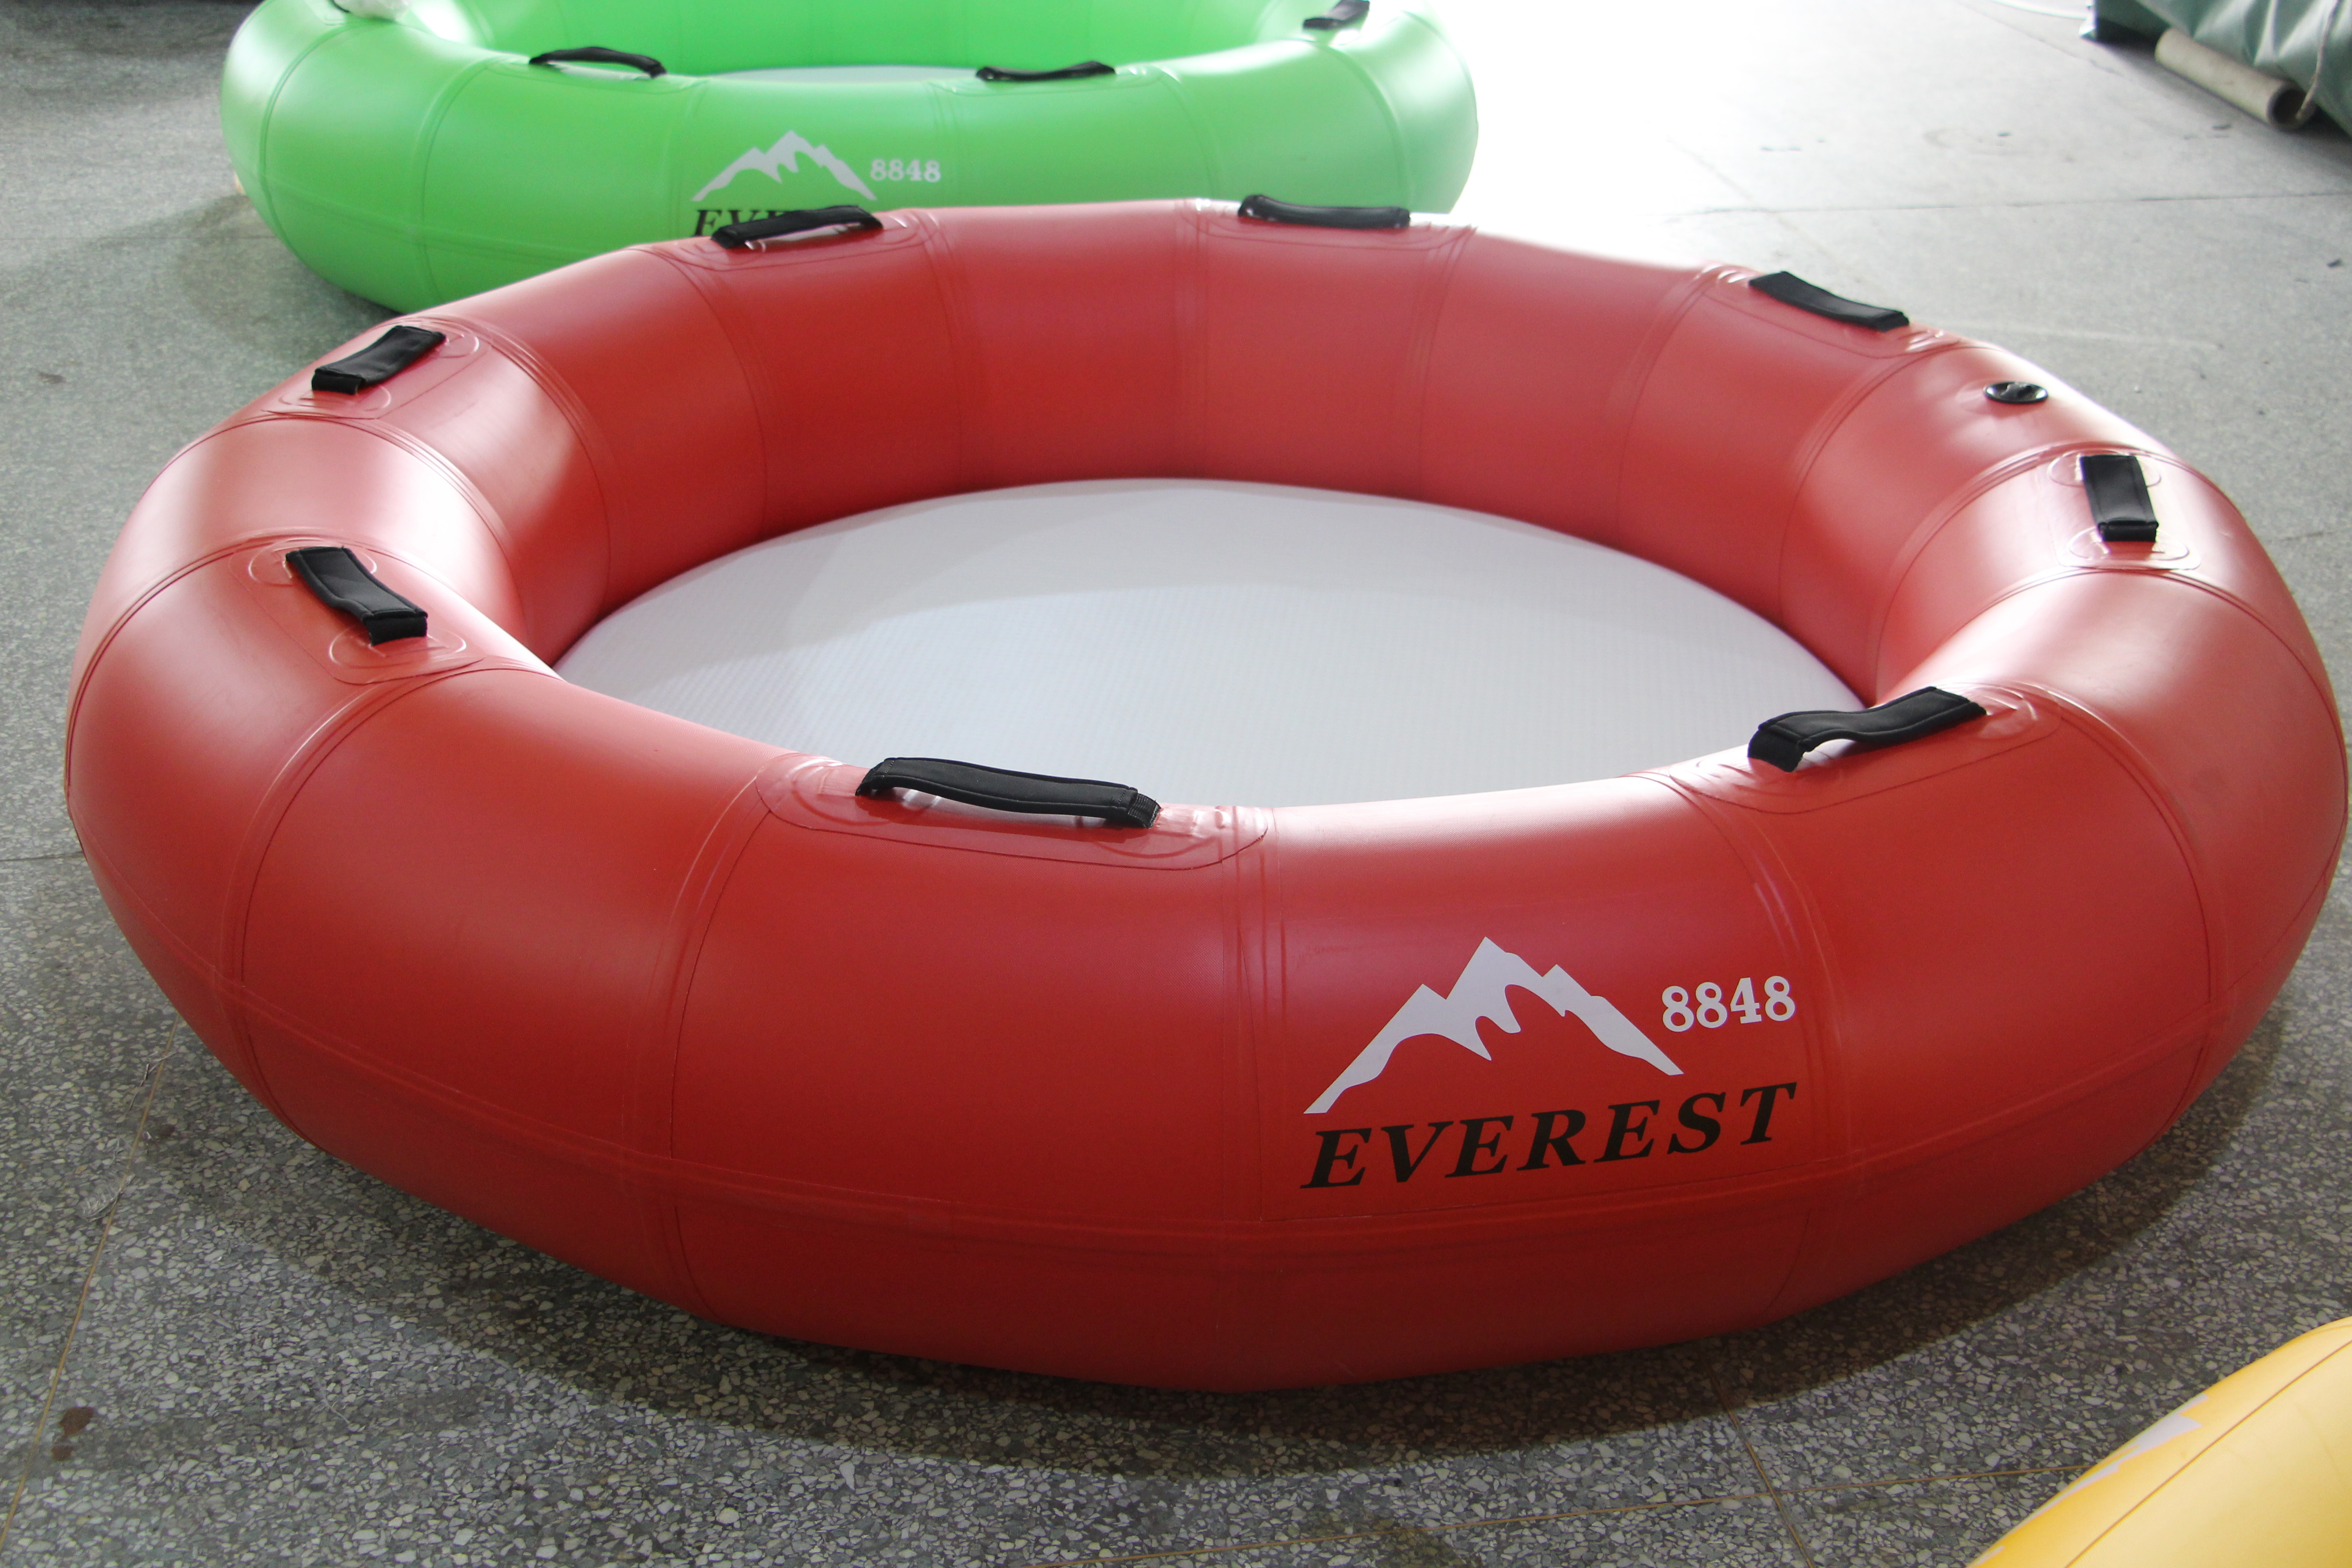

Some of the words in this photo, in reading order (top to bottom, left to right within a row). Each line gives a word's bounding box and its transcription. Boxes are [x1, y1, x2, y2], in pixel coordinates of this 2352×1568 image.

[870, 158, 941, 182] 8848
[1661, 975, 1795, 1032] 8848
[1300, 1082, 1797, 1189] EVEREST
